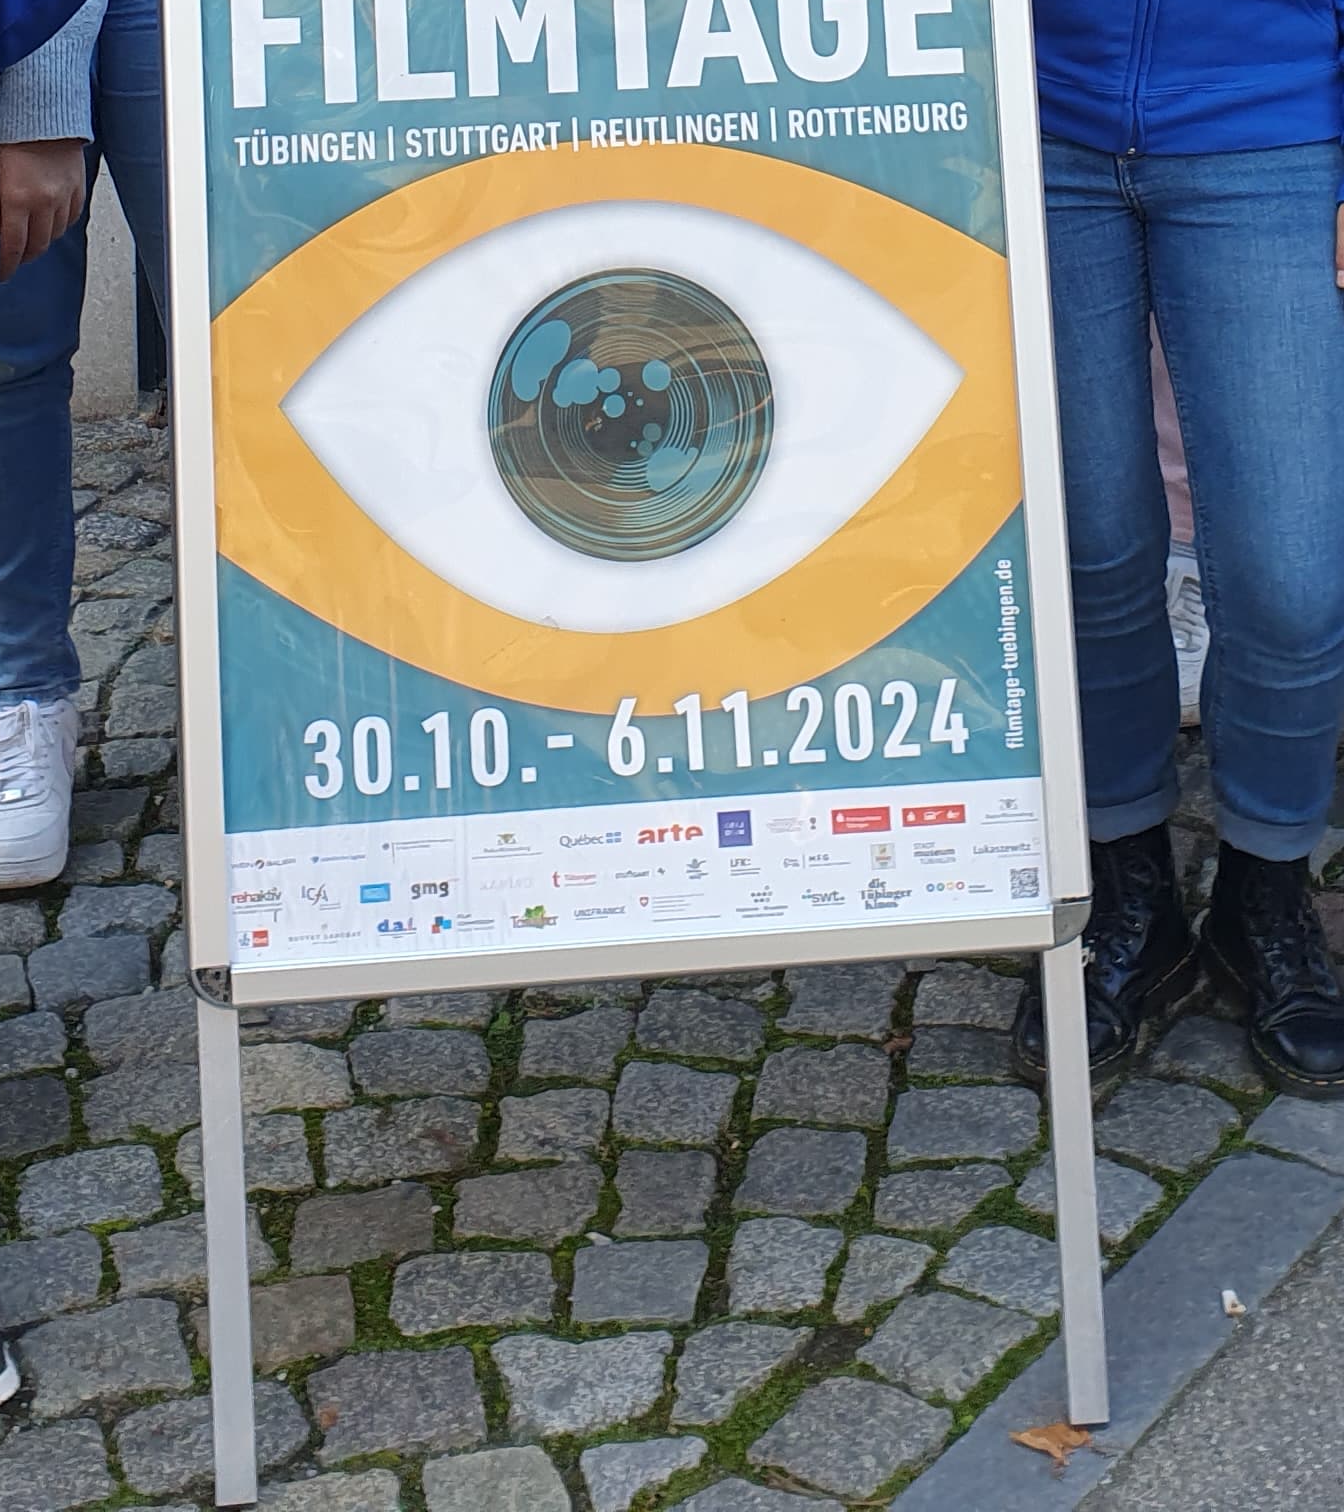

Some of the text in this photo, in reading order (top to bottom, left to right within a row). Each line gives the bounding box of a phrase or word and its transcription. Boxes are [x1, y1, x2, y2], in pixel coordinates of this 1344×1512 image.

[234, 126, 377, 168] TÜBINGEN
[405, 120, 562, 159] STUTTGART
[591, 110, 760, 150] REUTLINGEN
[788, 100, 969, 140] ROTTENBURG
[994, 559, 1026, 749] filmtage-tuebingen.de
[606, 677, 970, 779] 6.11.2024
[559, 832, 604, 848] Québec
[637, 824, 704, 845] arte
[411, 881, 449, 900] gmg
